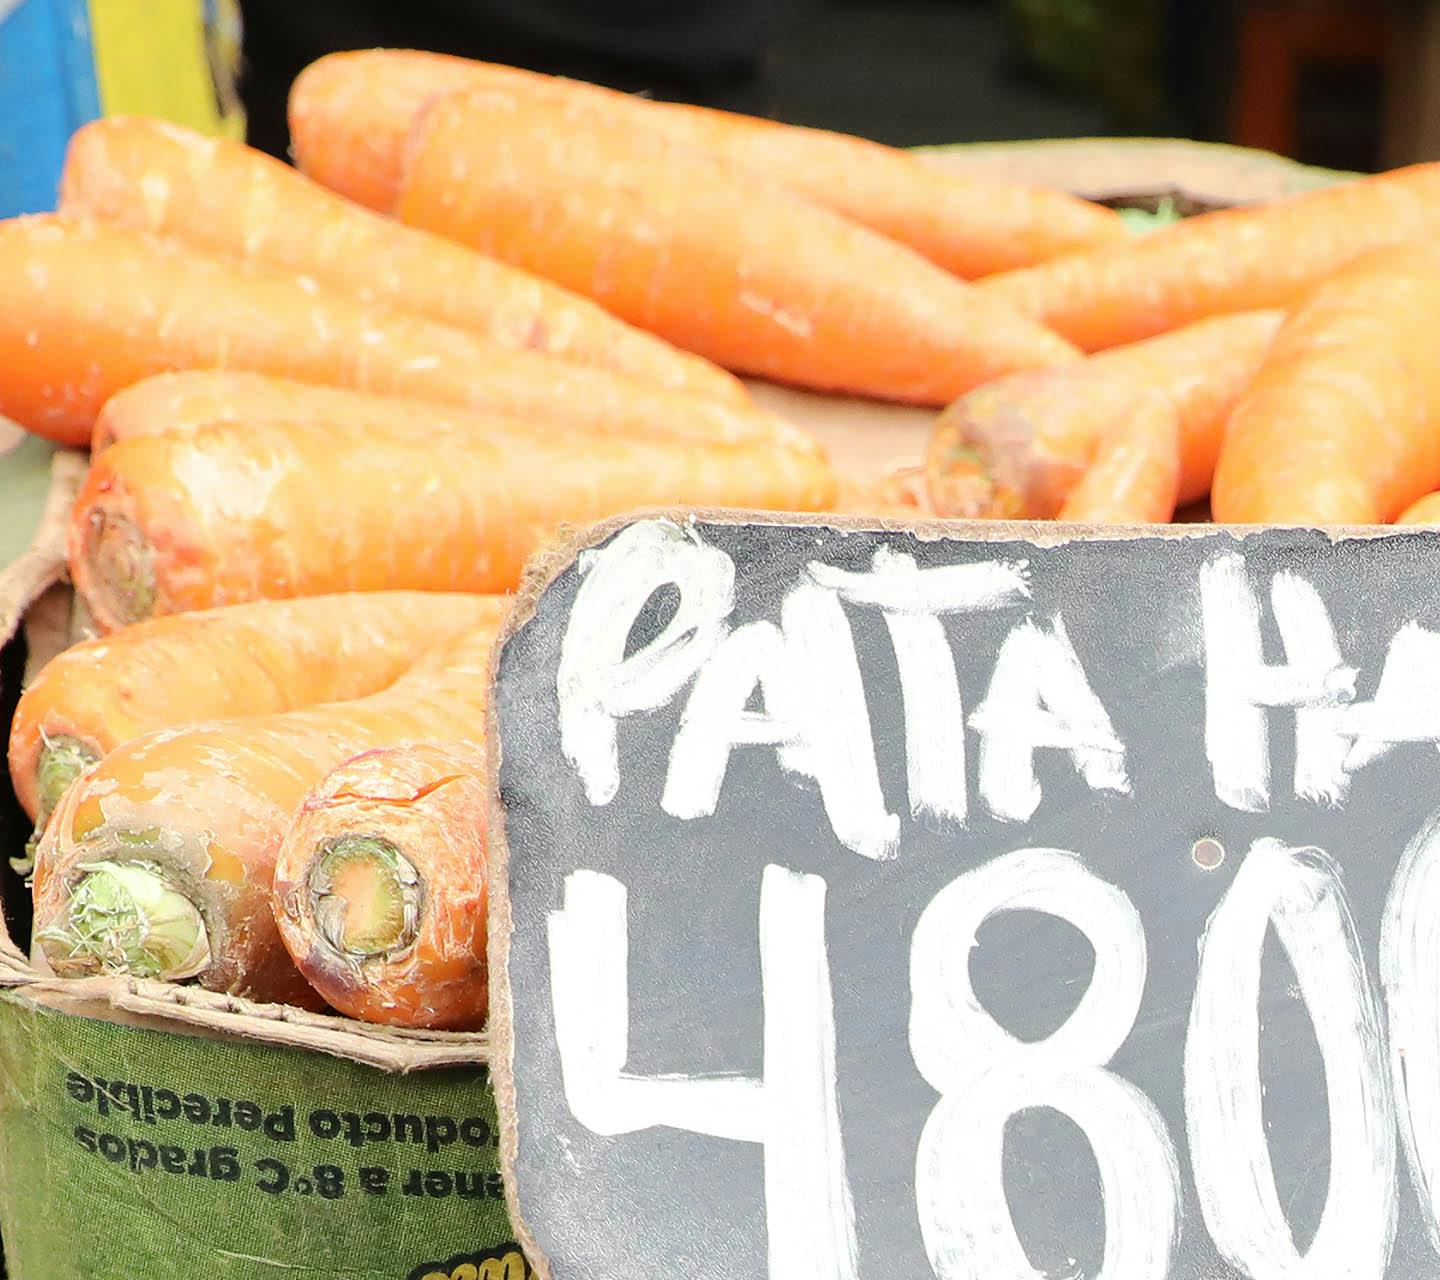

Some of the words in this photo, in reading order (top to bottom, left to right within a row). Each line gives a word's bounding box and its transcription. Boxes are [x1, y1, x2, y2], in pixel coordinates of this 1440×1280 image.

[64, 1071, 296, 1142] Perecible
[308, 1106, 501, 1153] oducto
[73, 1124, 243, 1183] grados
[358, 1166, 389, 1196] a
